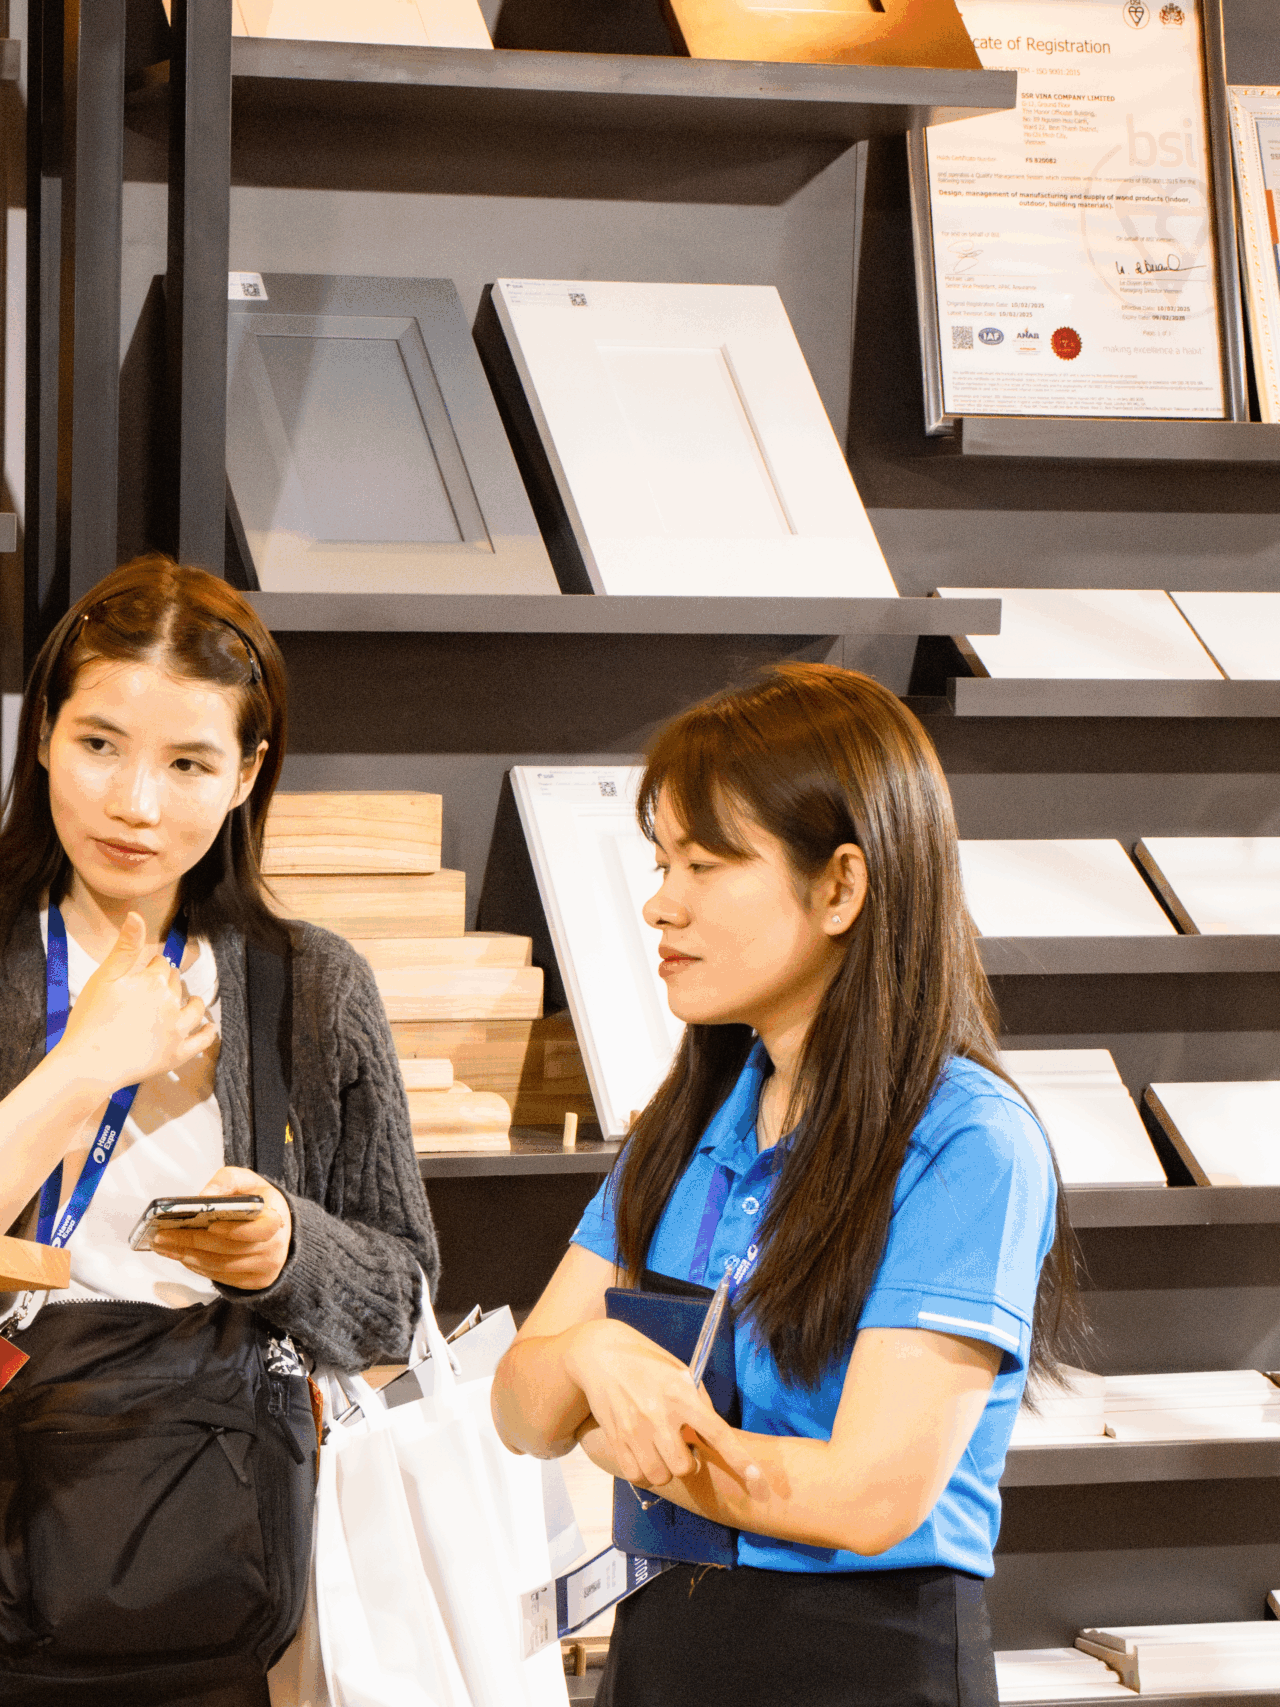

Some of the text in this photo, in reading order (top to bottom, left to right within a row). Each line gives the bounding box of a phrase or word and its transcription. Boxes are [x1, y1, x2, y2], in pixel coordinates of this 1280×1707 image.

[973, 36, 1110, 54] cate of Registration
[1127, 113, 1197, 169] bsi
[984, 332, 1000, 341] IAF
[97, 1125, 111, 1147] Hawa
[104, 1130, 116, 1150] Expo
[57, 1214, 72, 1236] Hawa
[62, 1219, 75, 1239] Expo
